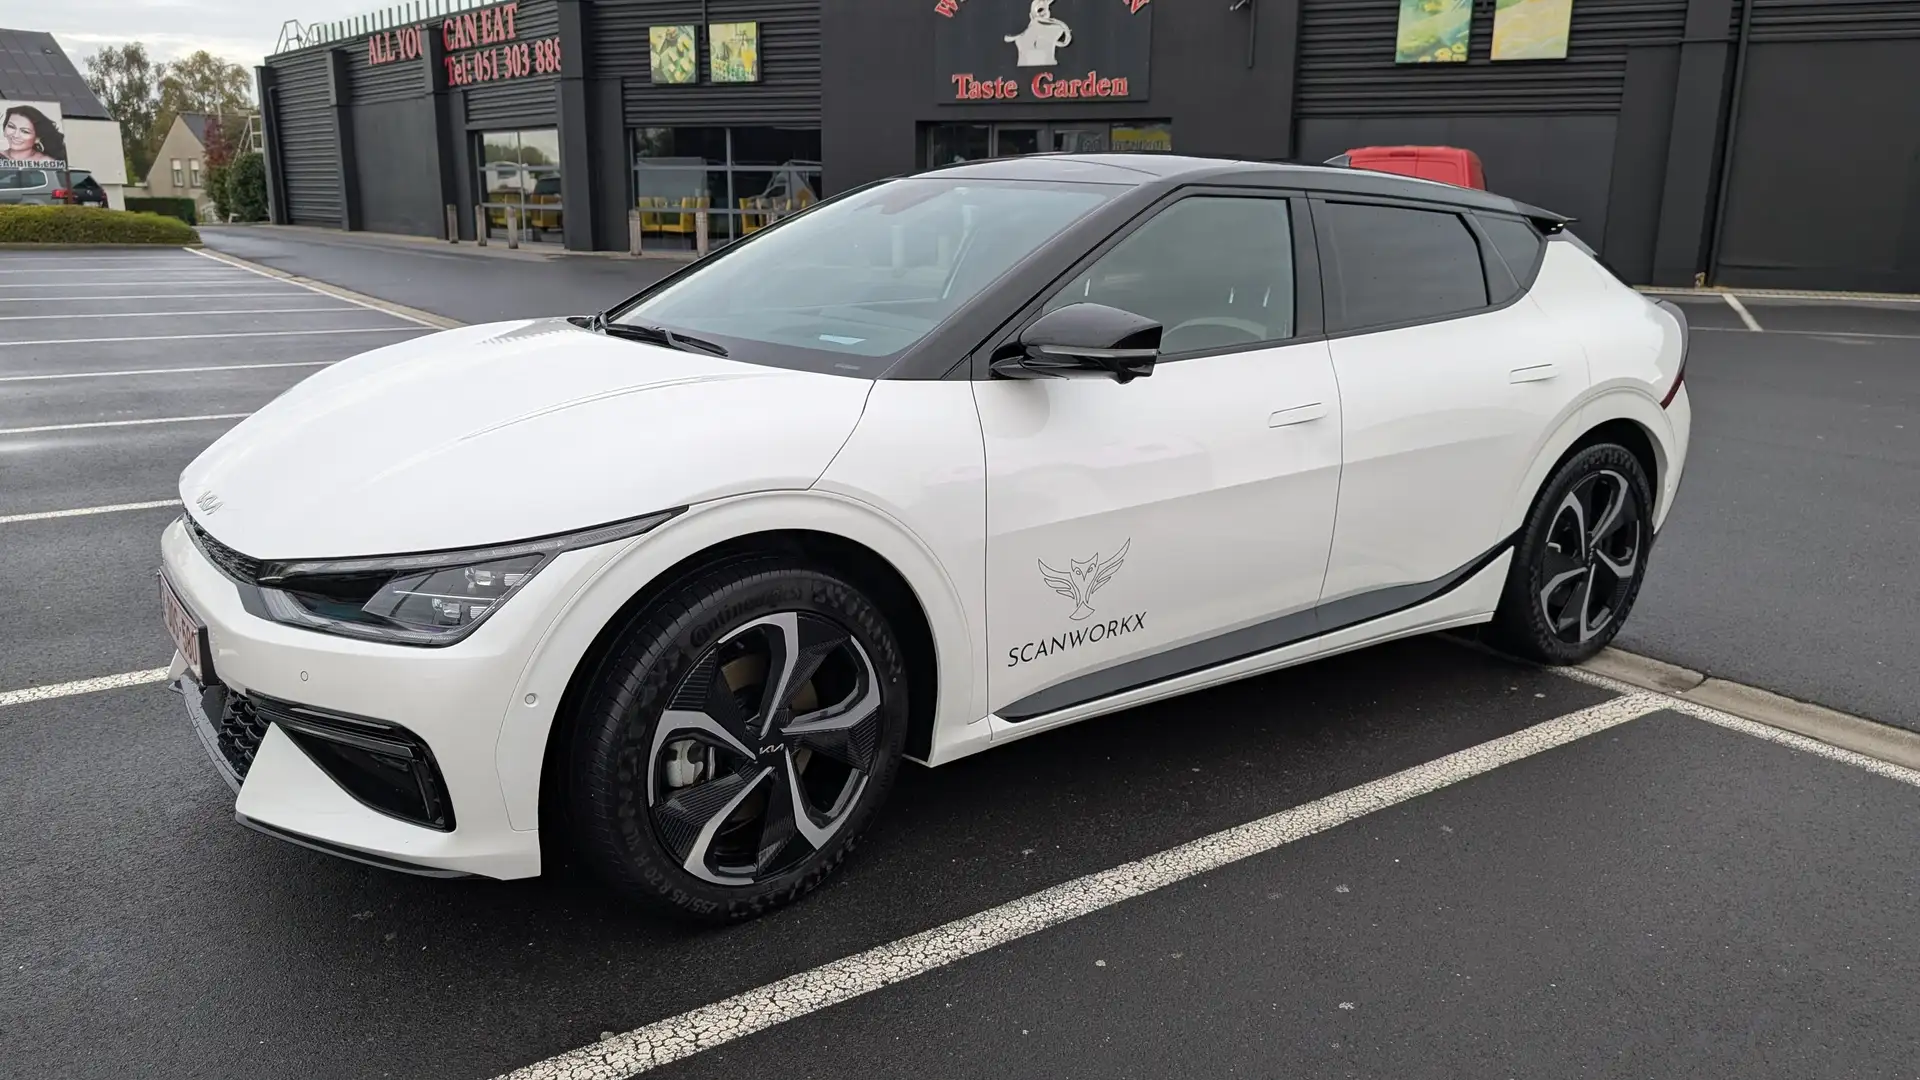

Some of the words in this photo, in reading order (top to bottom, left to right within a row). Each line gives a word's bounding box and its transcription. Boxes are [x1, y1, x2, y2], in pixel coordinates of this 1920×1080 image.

[368, 31, 396, 65] ALL
[443, 14, 478, 51] CAN
[480, 3, 518, 45] EAT
[445, 56, 473, 86] Tel:
[474, 48, 499, 82] 051
[503, 43, 531, 79] 303
[952, 73, 1018, 99] Taste
[1031, 70, 1129, 99] Garden
[1007, 611, 1148, 668] SCANWORKX
